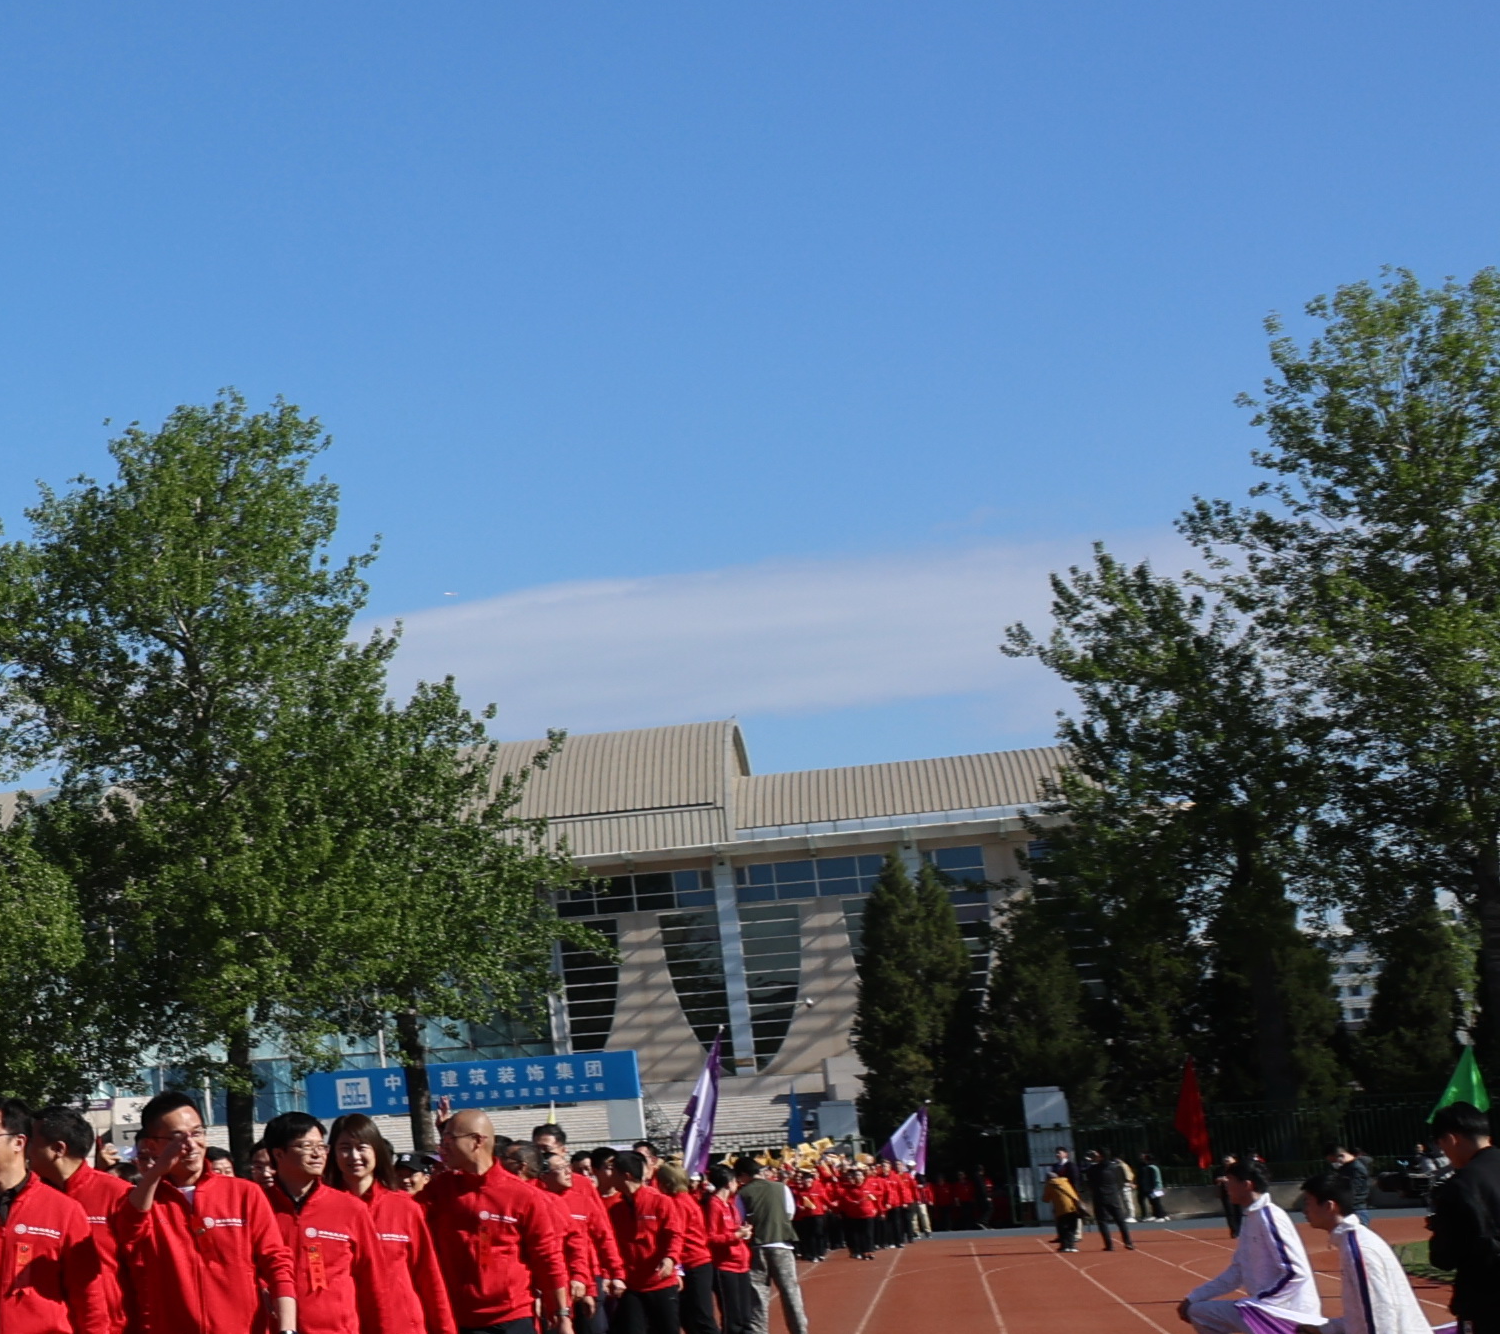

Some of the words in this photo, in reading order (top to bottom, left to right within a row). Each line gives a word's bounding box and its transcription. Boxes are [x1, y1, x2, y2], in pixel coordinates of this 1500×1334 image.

[383, 1060, 605, 1093] 中建筑装饰集团
